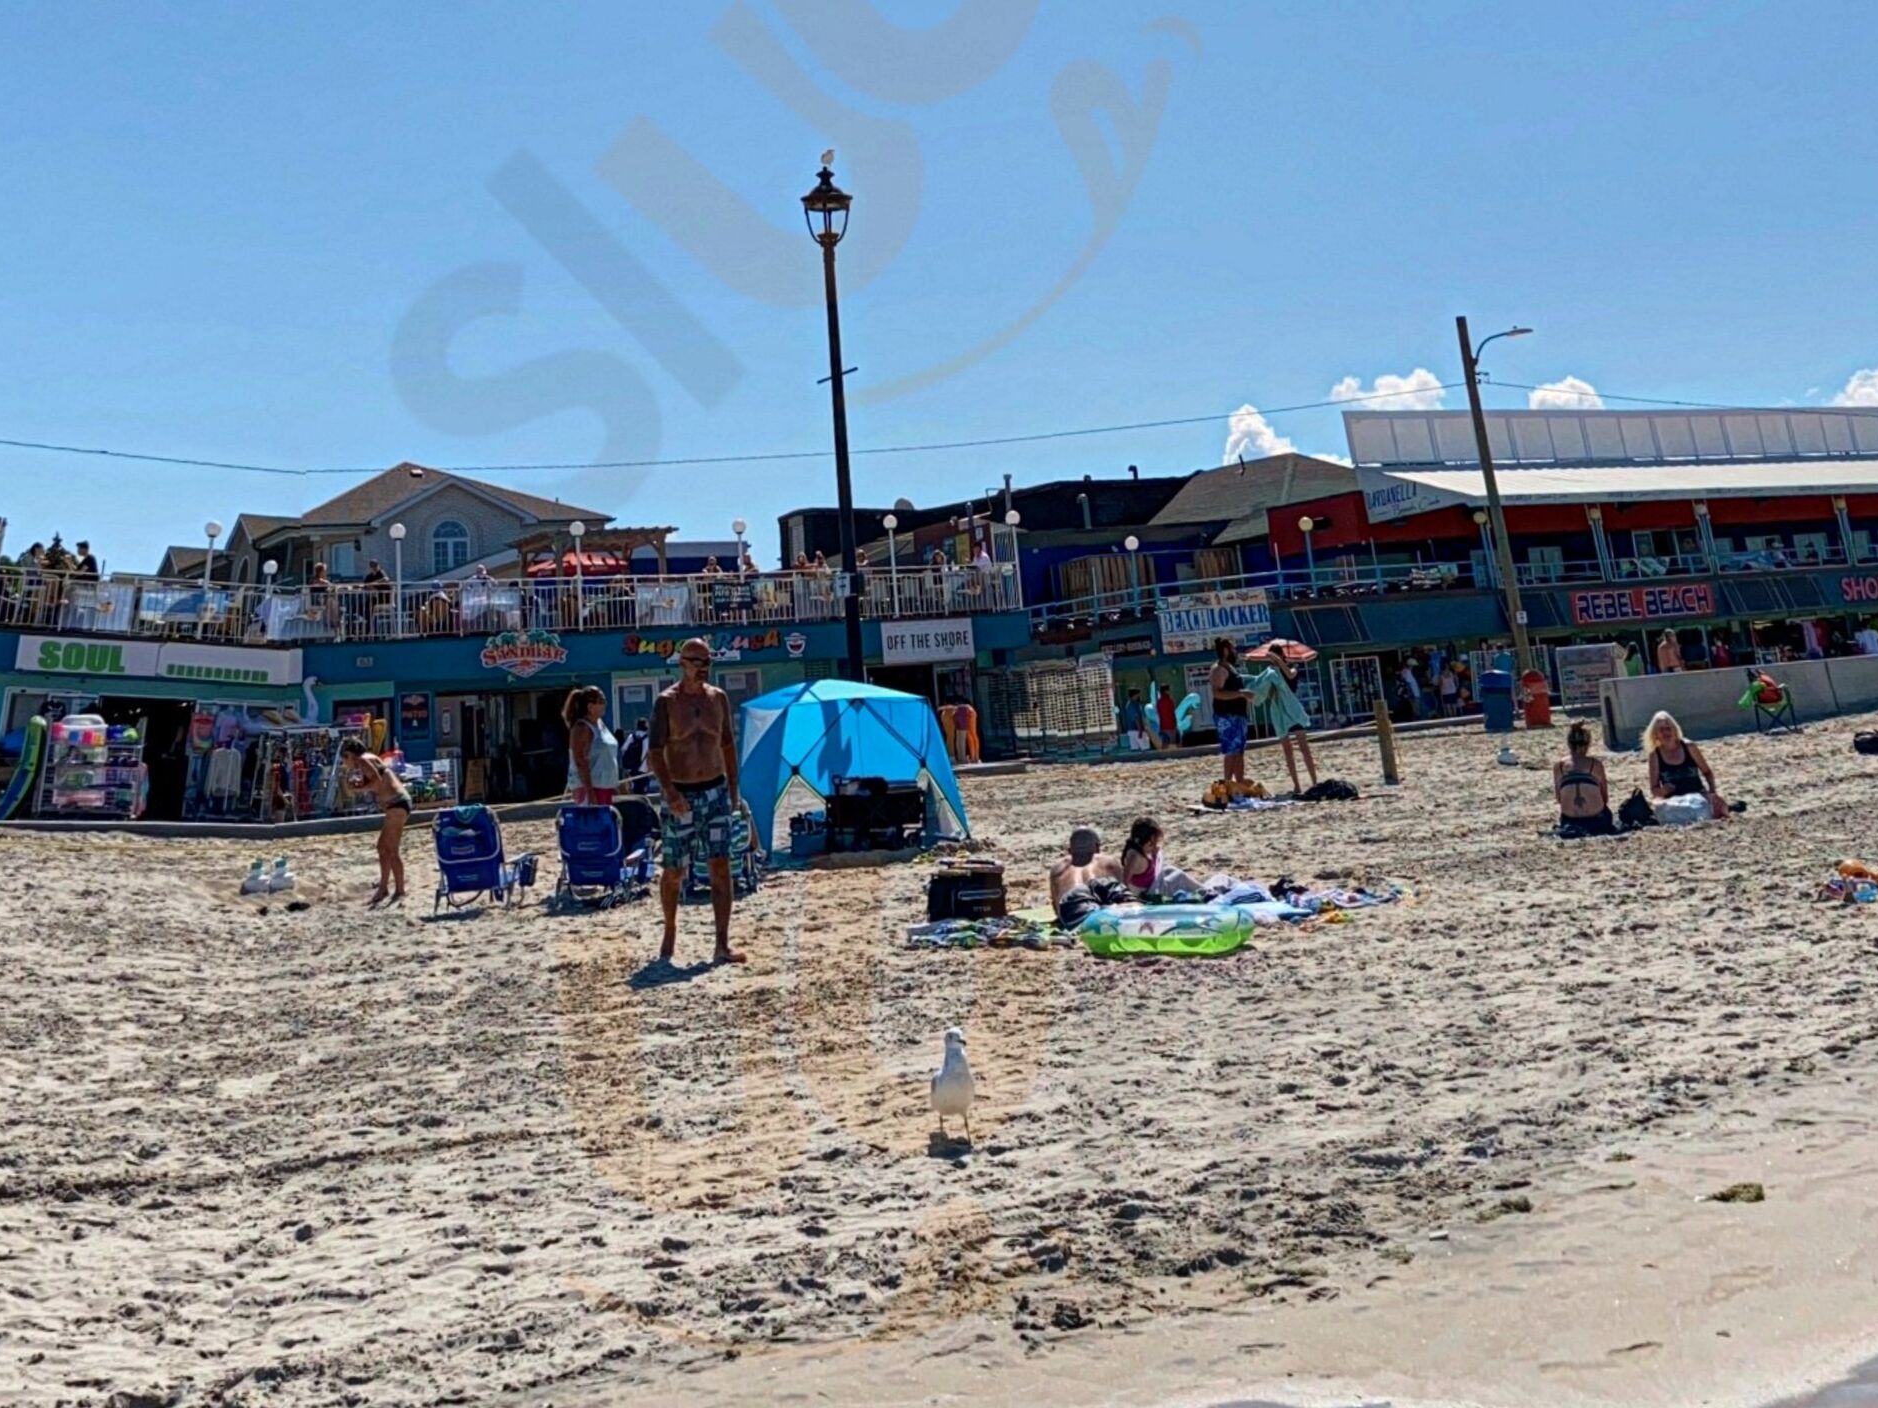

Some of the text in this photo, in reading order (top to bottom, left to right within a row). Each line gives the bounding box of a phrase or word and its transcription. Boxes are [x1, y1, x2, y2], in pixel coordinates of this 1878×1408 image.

[1575, 585, 1710, 623] REBEL BEACH
[37, 640, 125, 673] SOUL
[886, 630, 969, 650] OFF THE SHORE
